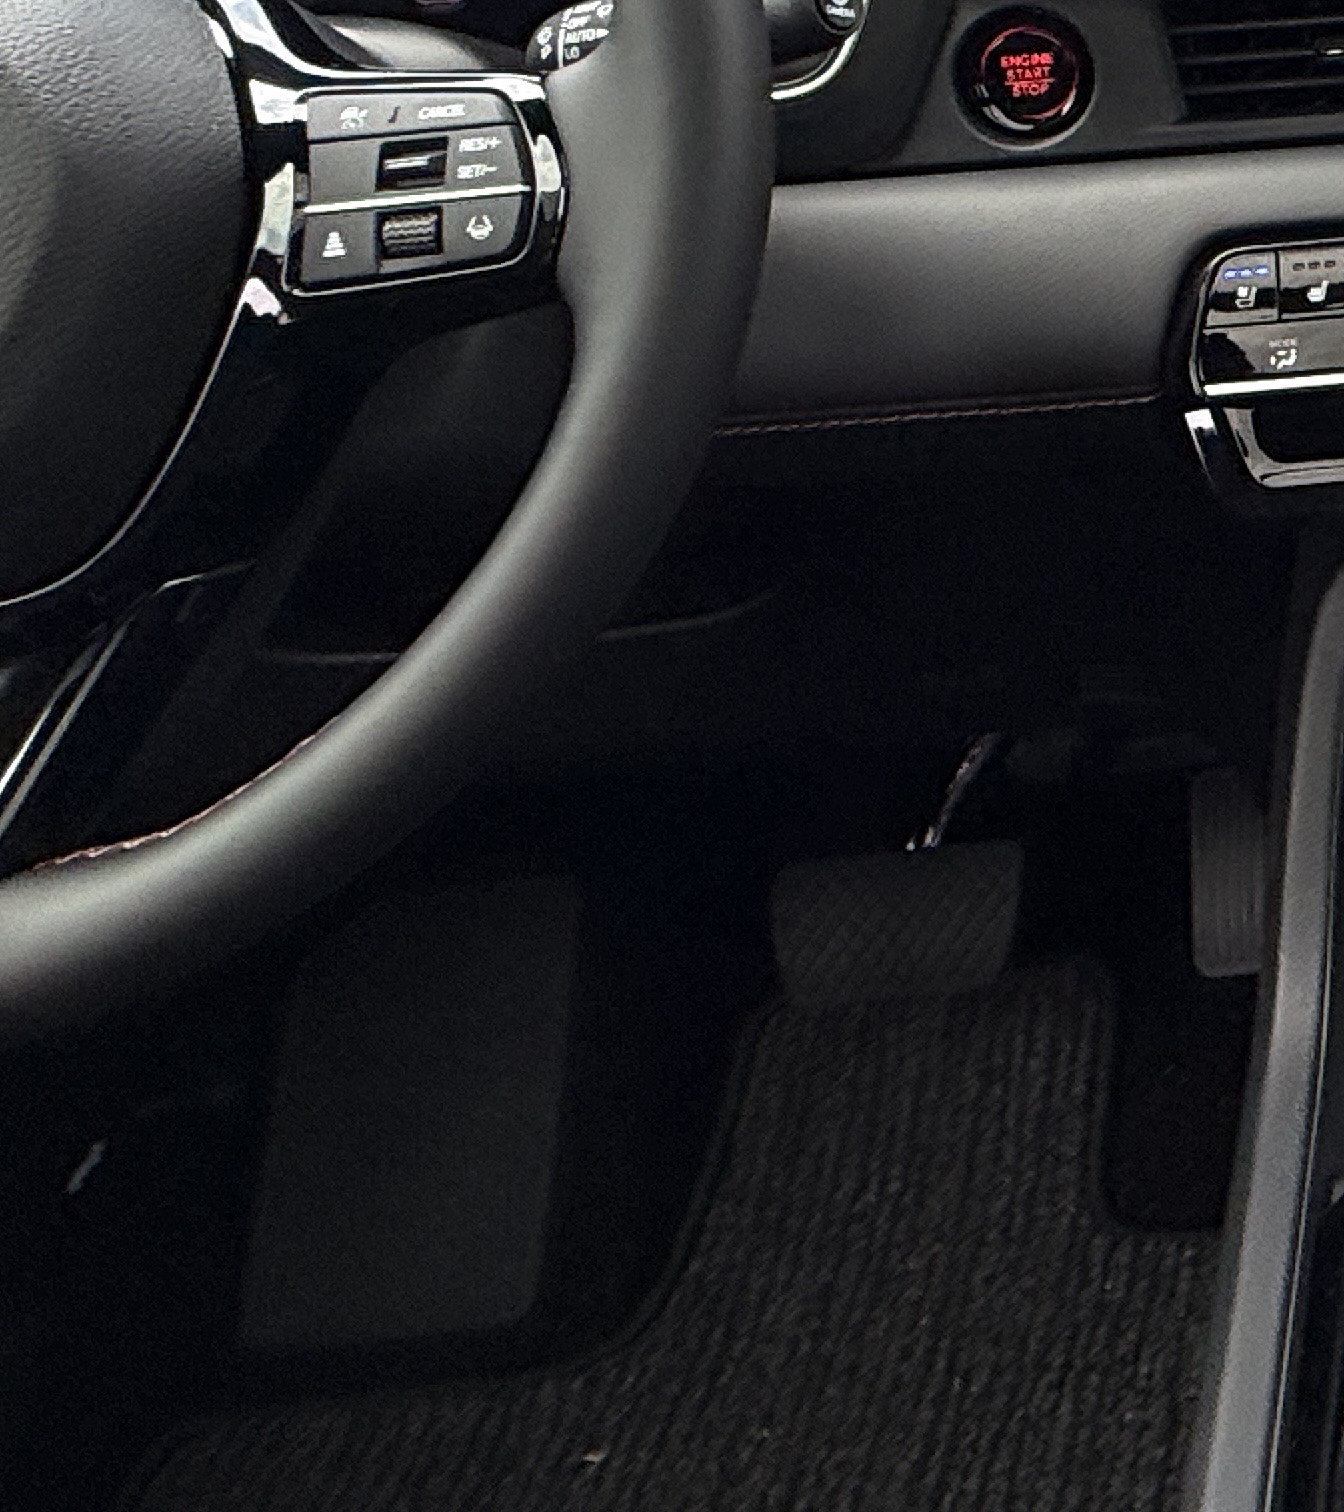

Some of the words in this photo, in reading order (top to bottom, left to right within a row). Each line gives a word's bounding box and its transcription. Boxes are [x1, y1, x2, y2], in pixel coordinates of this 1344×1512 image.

[1001, 52, 1054, 68] ENGINE
[1006, 67, 1051, 82] START
[1012, 83, 1050, 98] STOP
